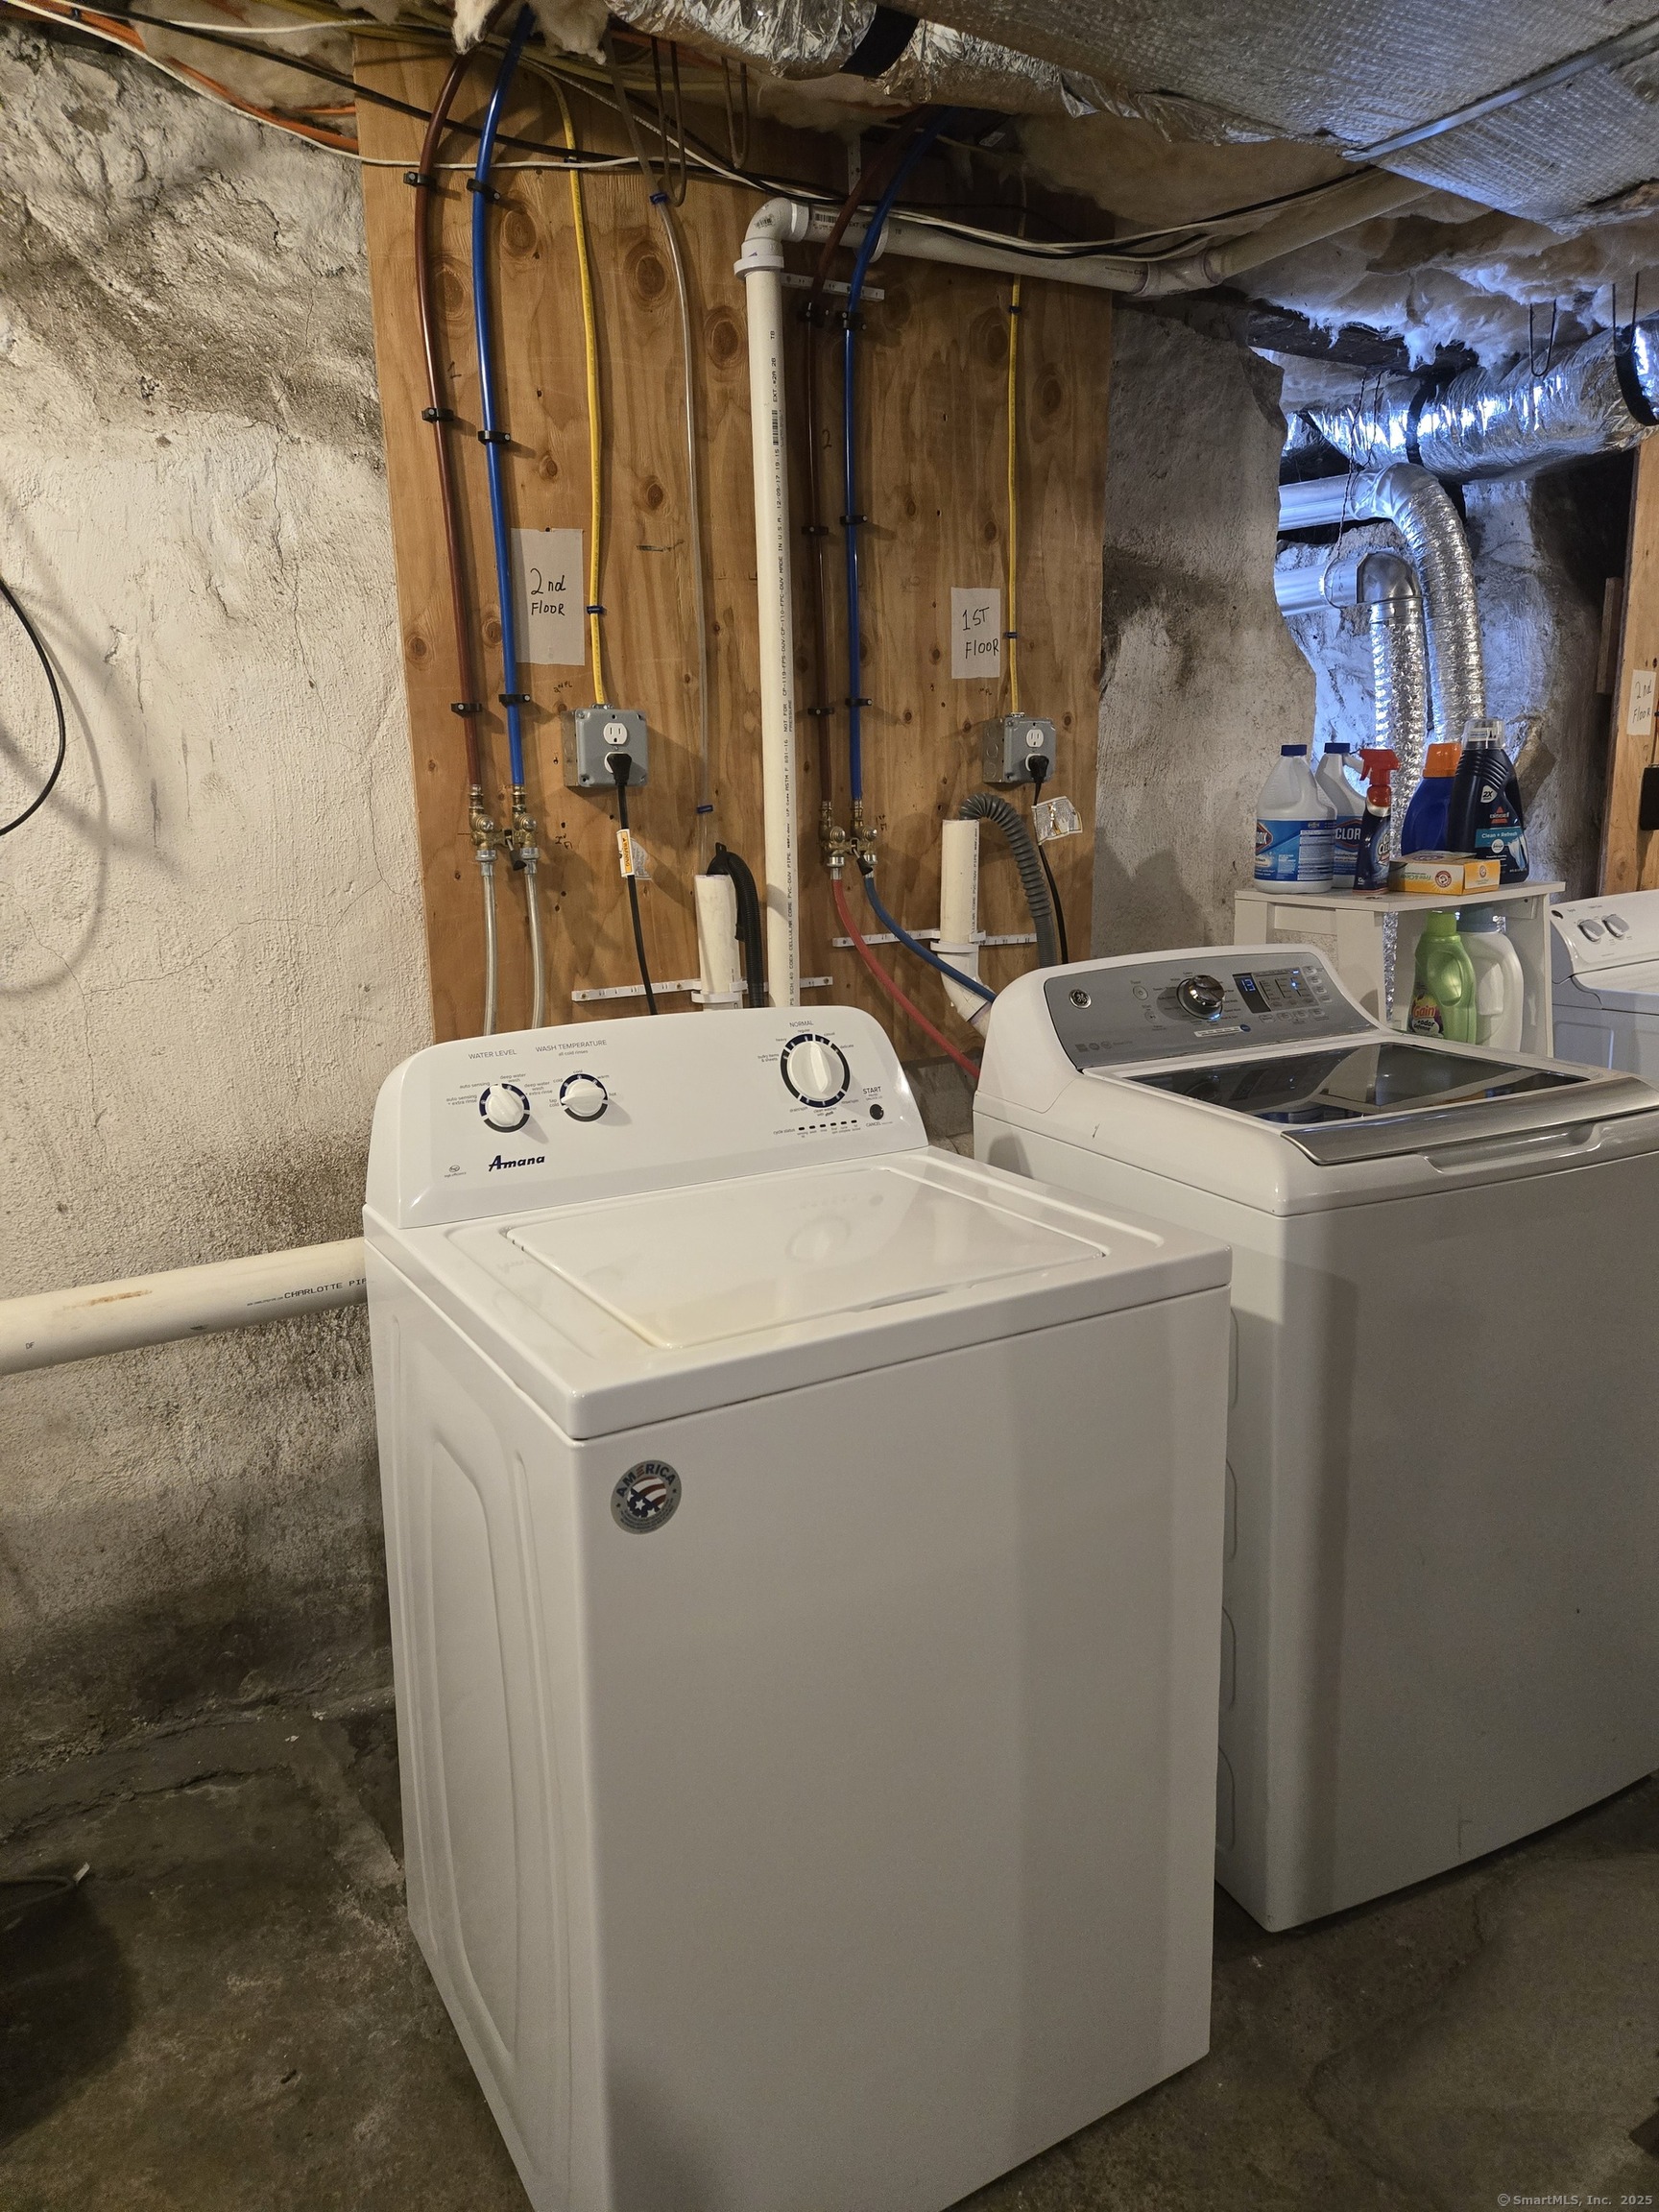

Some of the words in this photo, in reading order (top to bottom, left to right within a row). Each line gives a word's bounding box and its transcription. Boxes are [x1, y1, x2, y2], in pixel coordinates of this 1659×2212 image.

[778, 543, 783, 551] IN
[530, 567, 566, 595] 2nd
[962, 606, 990, 631] 1ST
[1413, 1005, 1436, 1018] Gain
[558, 1039, 607, 1050] TEMPERATURE
[468, 1051, 494, 1060] WATER
[488, 1155, 545, 1172] Amana
[284, 1282, 343, 1299] CHARLOTTE
[616, 1463, 676, 1498] AMERICA
